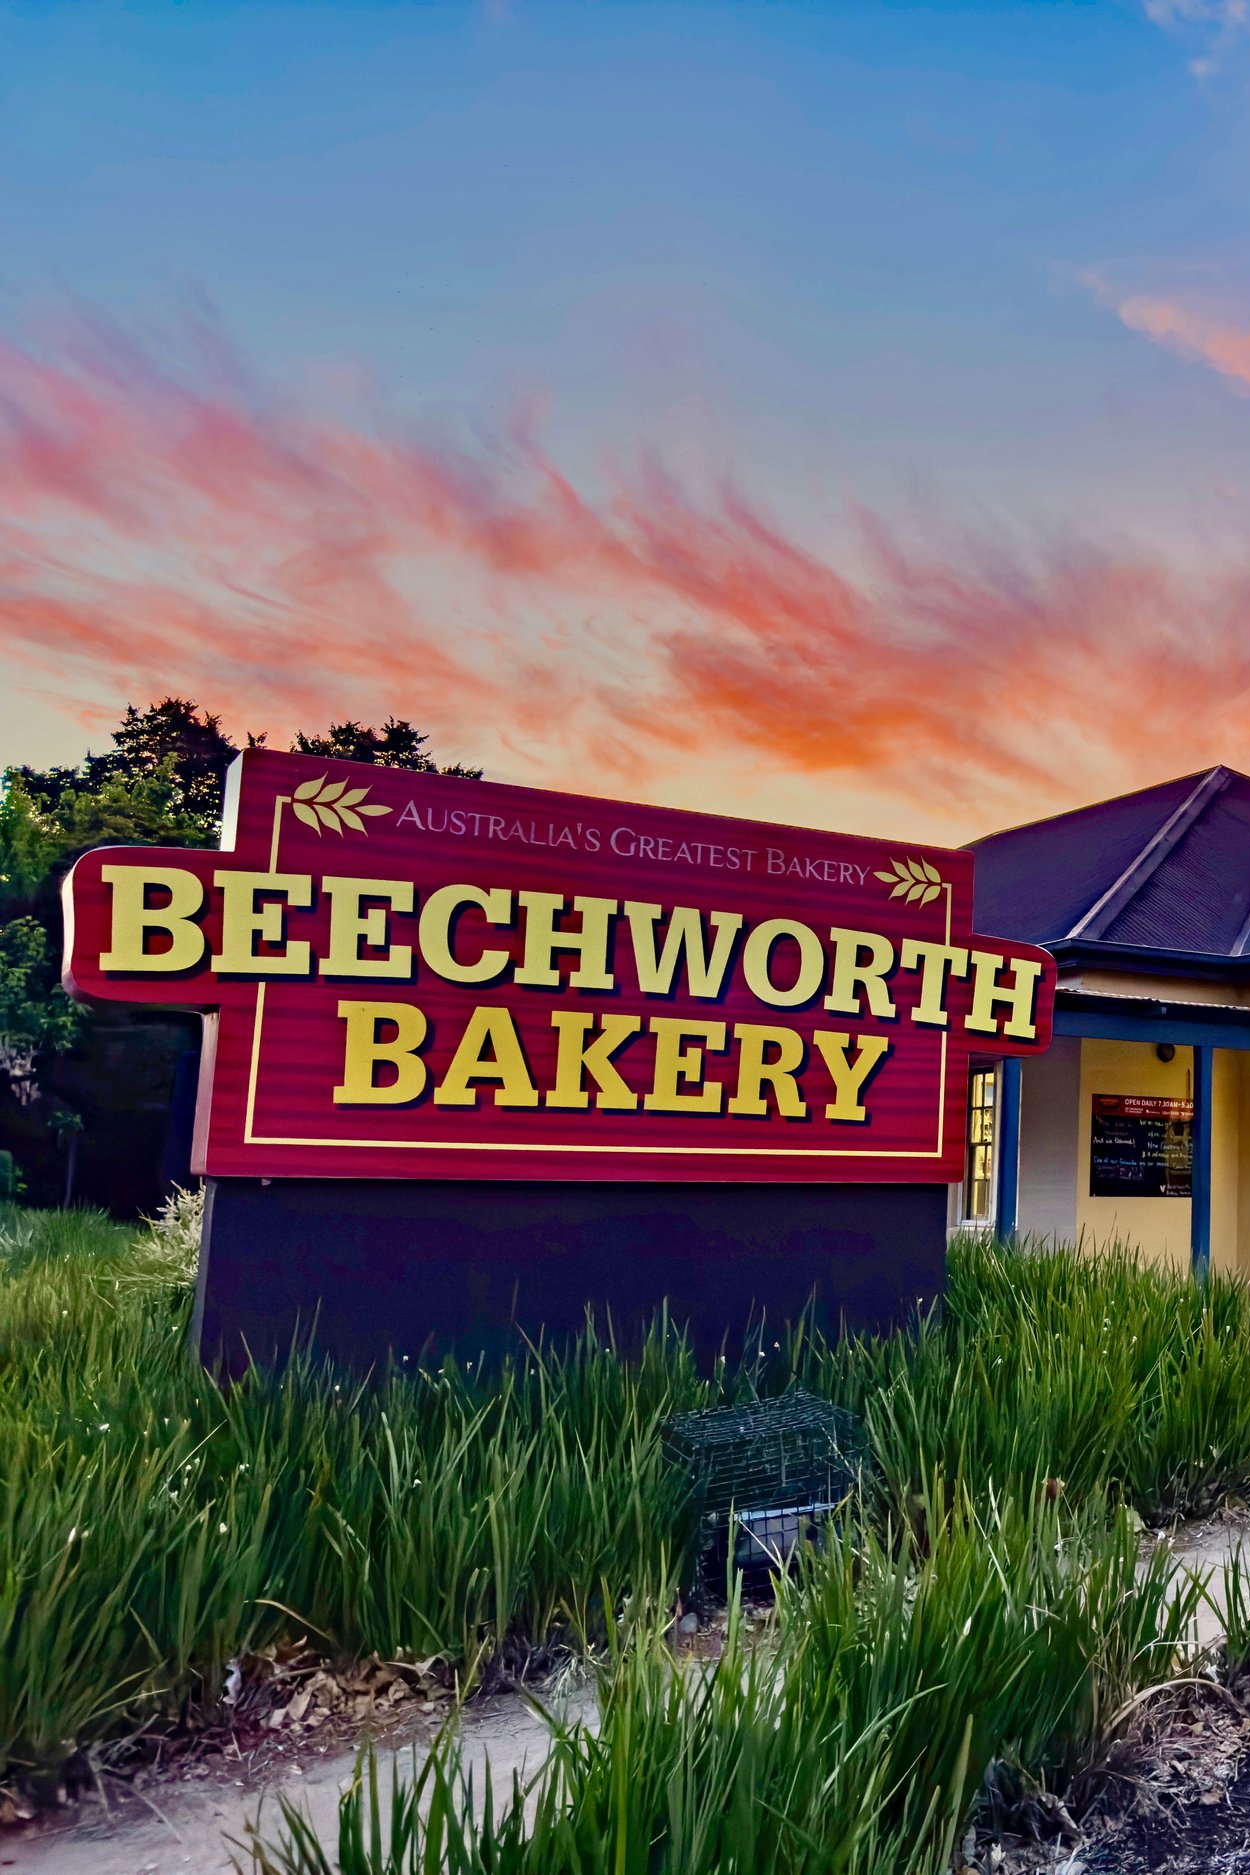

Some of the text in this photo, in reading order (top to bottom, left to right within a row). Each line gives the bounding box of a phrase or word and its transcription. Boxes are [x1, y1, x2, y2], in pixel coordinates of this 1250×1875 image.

[396, 799, 871, 885] AUSTRALIA'S GREATEST BAKERY
[99, 864, 1041, 1039] BEECHWORTH
[332, 1000, 888, 1122] BAKERY
